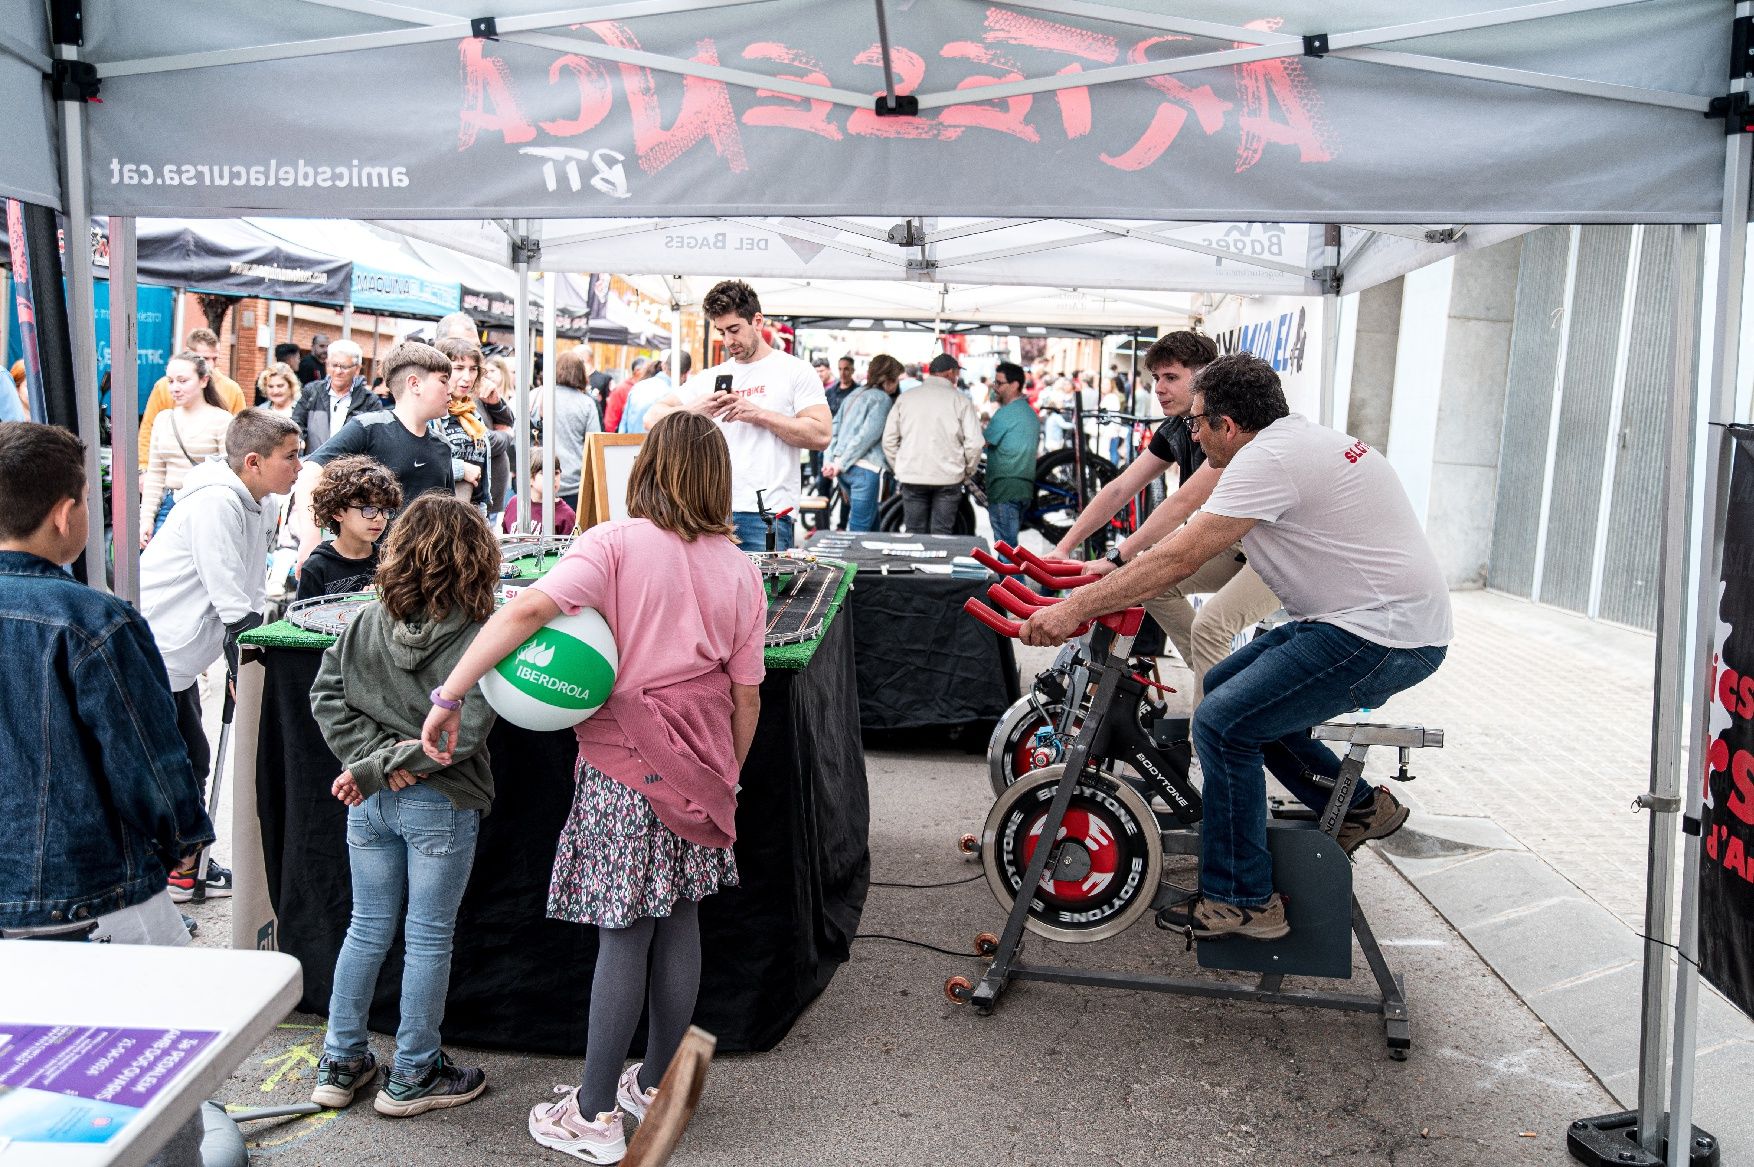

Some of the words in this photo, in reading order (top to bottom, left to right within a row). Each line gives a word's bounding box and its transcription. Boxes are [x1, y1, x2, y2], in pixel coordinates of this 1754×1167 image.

[515, 665, 590, 701] IBERDROLA
[1136, 752, 1189, 807] BODYTONE
[1324, 776, 1352, 833] BODYTON
[1058, 856, 1144, 924] BODYTONE
